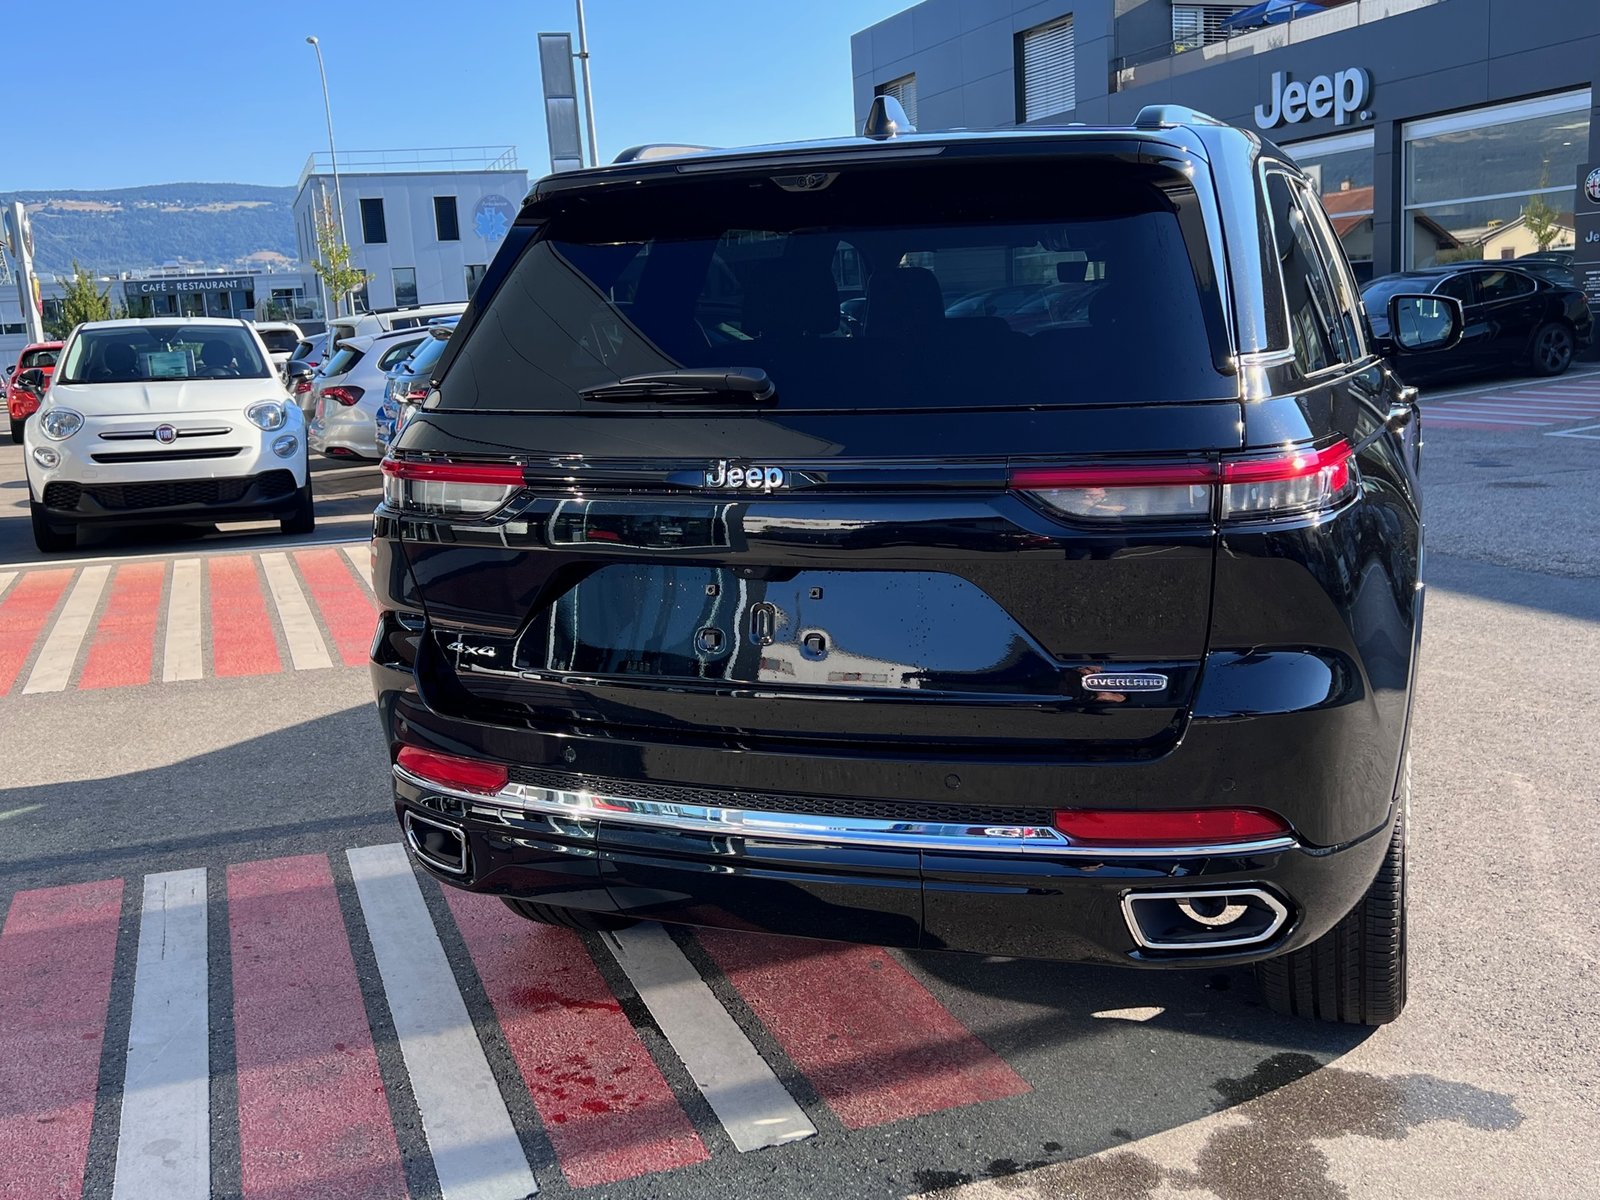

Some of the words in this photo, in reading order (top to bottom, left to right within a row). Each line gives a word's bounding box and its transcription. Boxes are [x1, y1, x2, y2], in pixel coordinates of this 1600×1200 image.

[1254, 67, 1368, 130] Jeep
[141, 282, 167, 292] CAFÉ
[176, 280, 238, 291] RESTAURANT
[706, 460, 784, 494] Jeep
[447, 642, 496, 657] 4x4
[1086, 677, 1163, 687] OVERLAND
